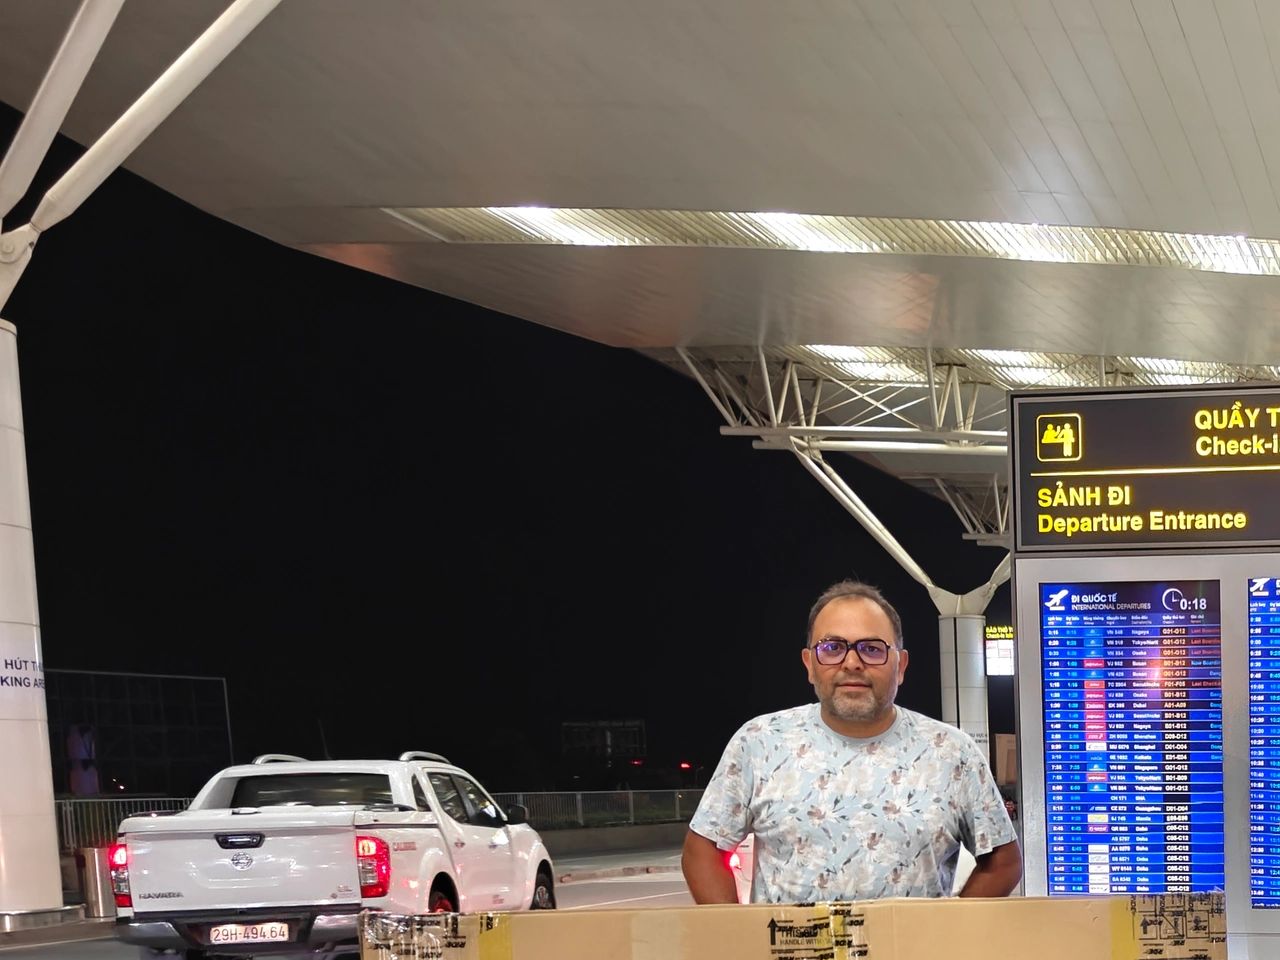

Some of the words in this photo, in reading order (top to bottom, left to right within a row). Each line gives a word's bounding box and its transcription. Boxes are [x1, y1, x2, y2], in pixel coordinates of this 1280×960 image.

[1194, 401, 1260, 430] QUẦY
[1037, 481, 1100, 507] SẢNH
[1107, 486, 1130, 505] ĐI
[1037, 514, 1143, 536] Departure
[1150, 511, 1246, 530] Entrance
[1071, 595, 1079, 603] ĐI
[1081, 593, 1107, 602] QUỐC
[1108, 593, 1117, 602] TẾ
[1180, 598, 1207, 610] 0:18
[5, 657, 29, 670] HÚT
[0, 676, 31, 688] KING
[213, 926, 286, 941] 29H-494.64
